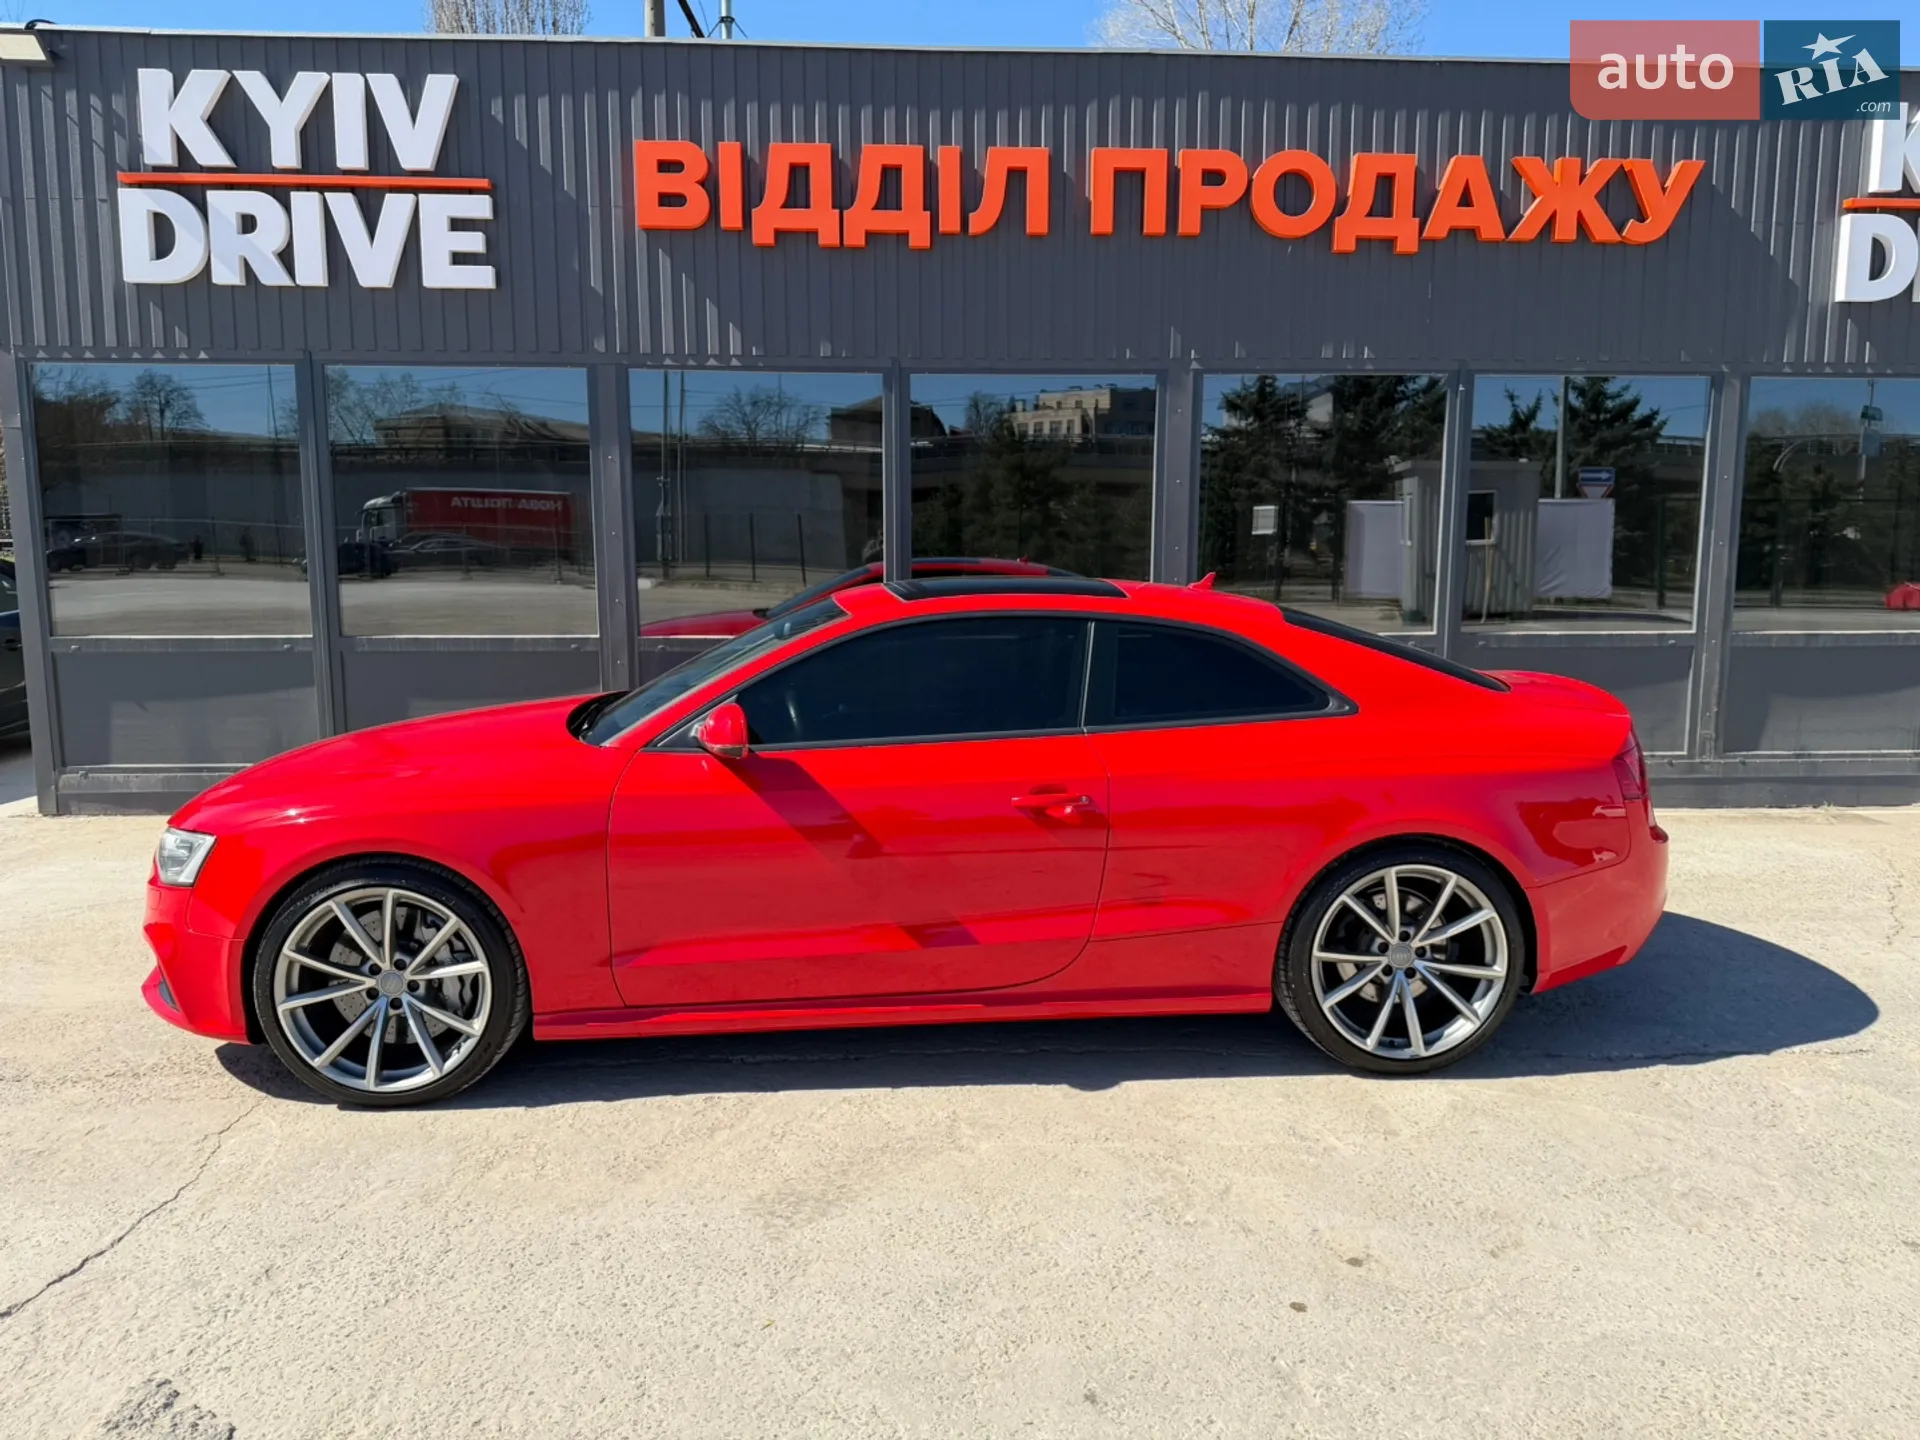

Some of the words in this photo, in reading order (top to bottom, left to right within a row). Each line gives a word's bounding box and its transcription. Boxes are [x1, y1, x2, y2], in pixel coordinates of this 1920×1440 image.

[137, 68, 459, 170] KYIV
[117, 187, 497, 289] DRIVE
[633, 139, 1050, 249] ВІДДІЛ
[1090, 147, 1706, 254] ПРОДАЖУ
